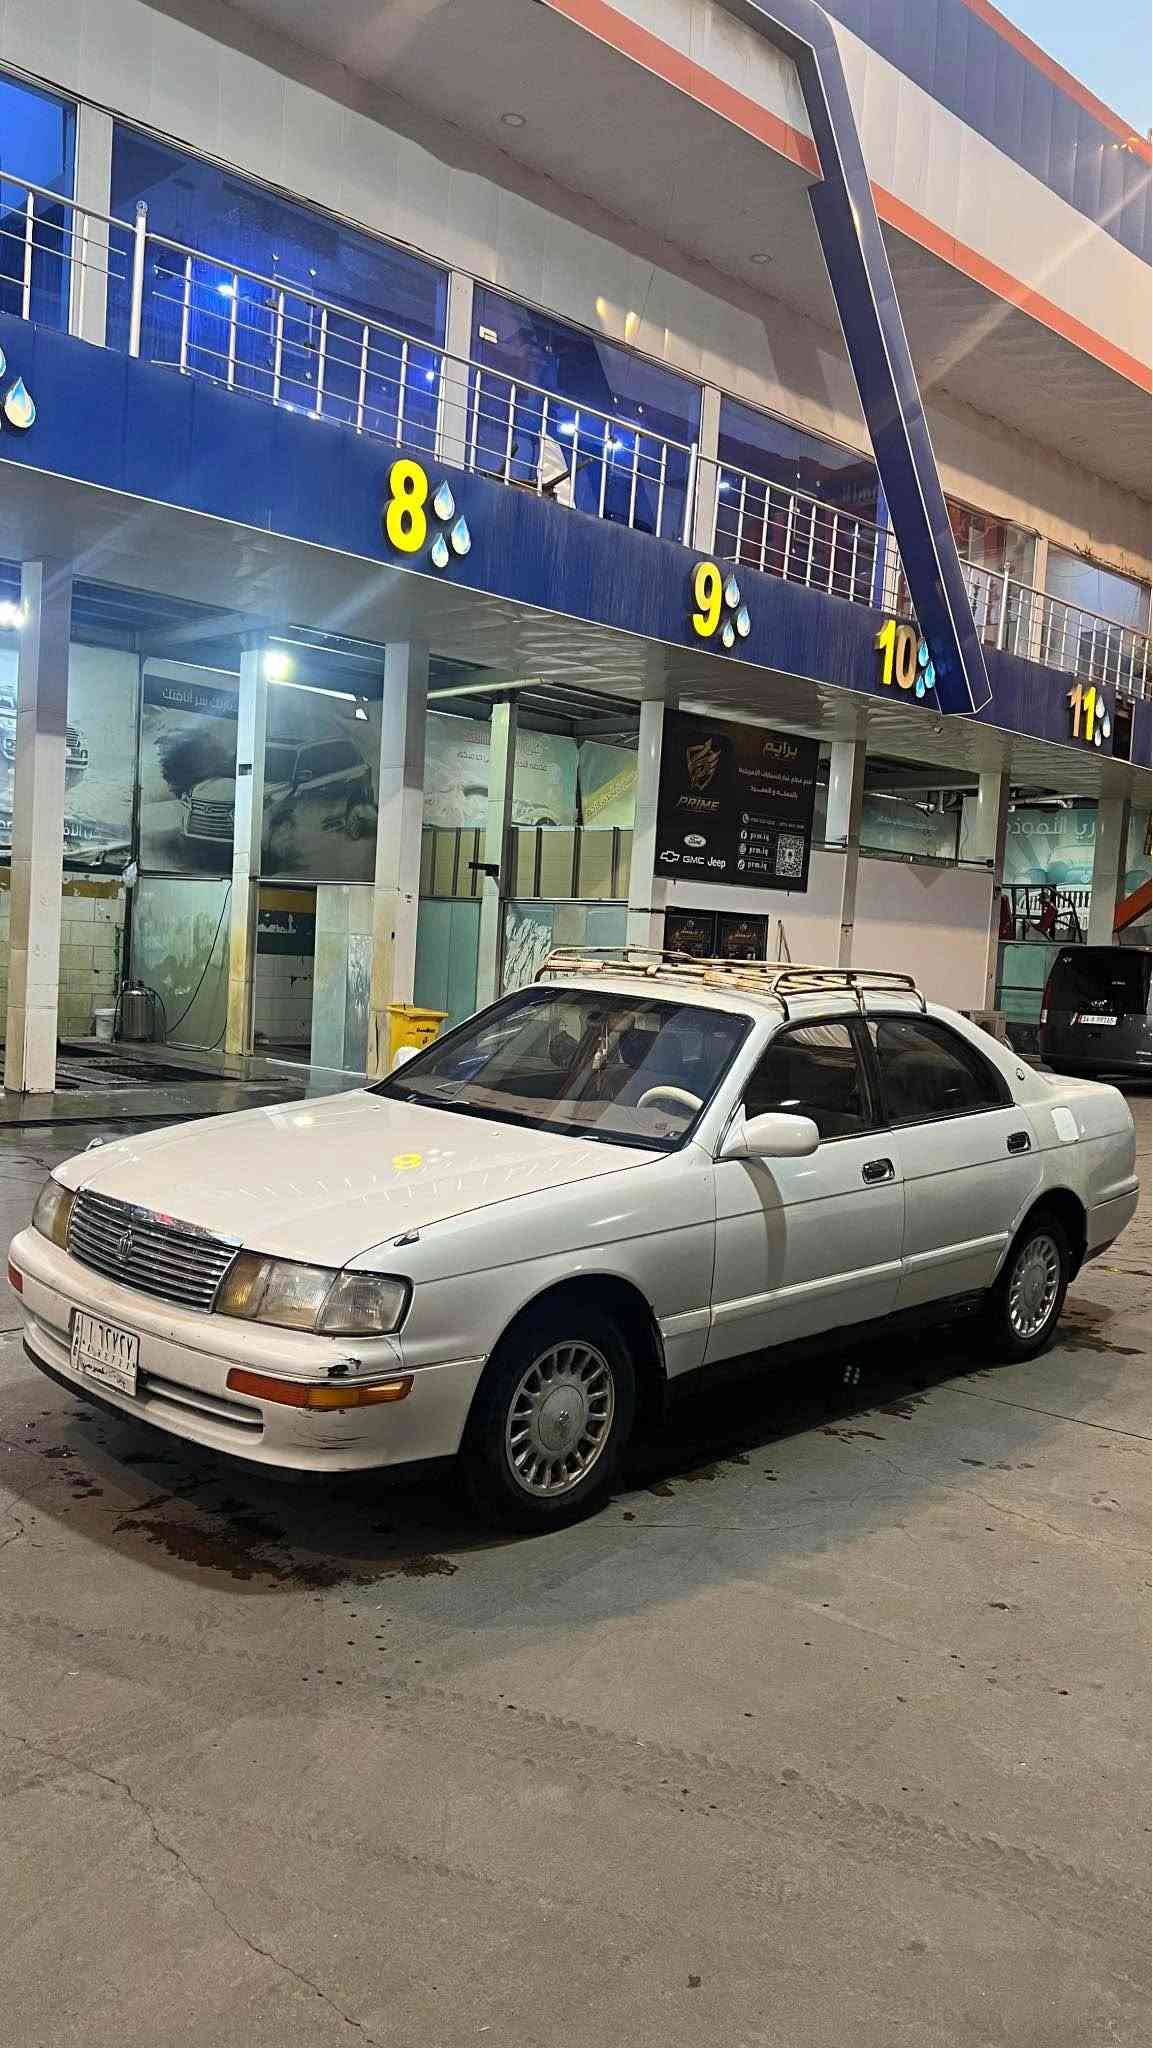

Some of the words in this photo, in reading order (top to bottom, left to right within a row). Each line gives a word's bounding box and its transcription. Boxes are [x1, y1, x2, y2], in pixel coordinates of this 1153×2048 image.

[386, 459, 428, 553] 8
[691, 561, 723, 638] 9
[875, 619, 917, 689] 10
[1067, 683, 1097, 741] 11
[765, 742, 798, 759] برايم
[676, 796, 720, 809] PRIME
[682, 855, 705, 865] GMC
[707, 856, 726, 869] Jeep
